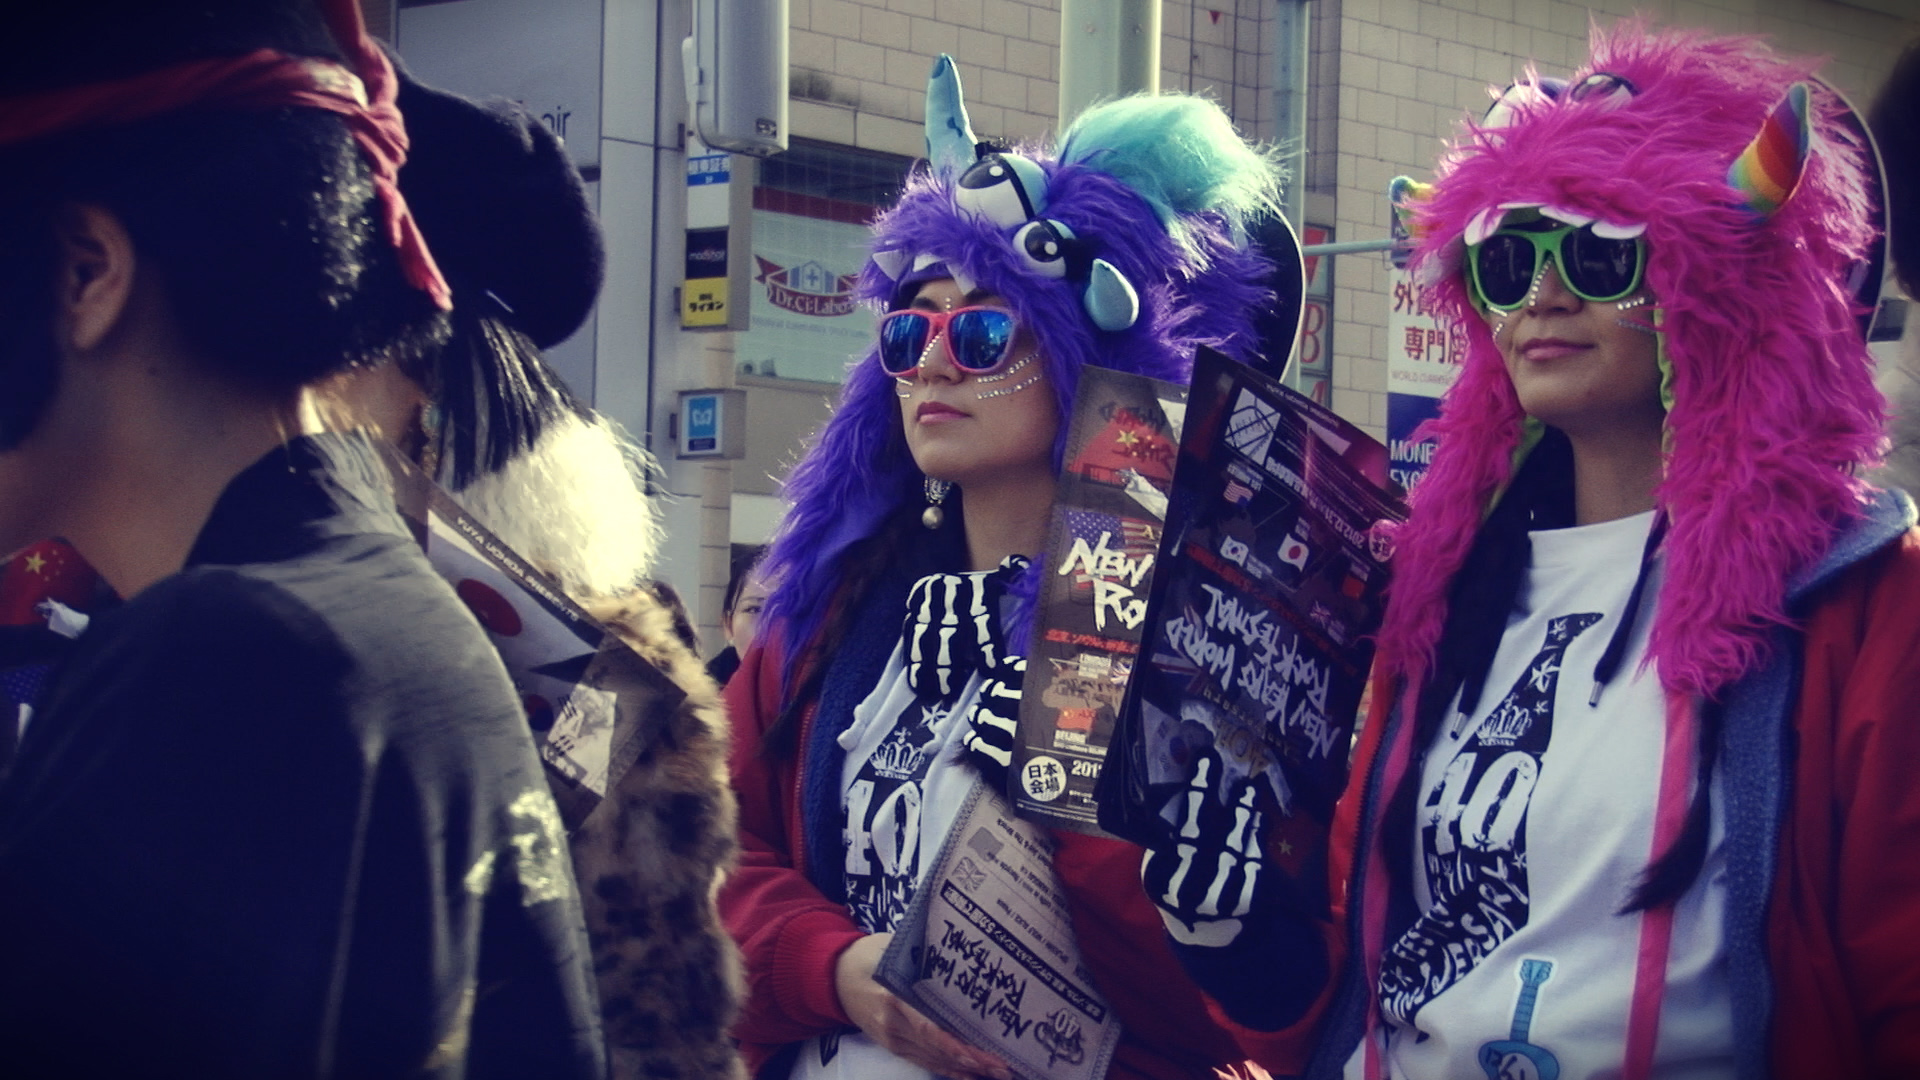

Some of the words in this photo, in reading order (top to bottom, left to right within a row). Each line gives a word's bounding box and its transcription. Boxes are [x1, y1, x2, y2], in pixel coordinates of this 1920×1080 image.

[1391, 439, 1436, 465] MONE
[1092, 578, 1148, 632] RO
[1202, 584, 1280, 667] FESTIVAL
[1166, 616, 1234, 690] WORLD
[1273, 634, 1331, 715] ROCK
[1235, 662, 1289, 733] YEARS
[1292, 700, 1342, 760] NEW
[1028, 762, 1058, 778] 日本
[937, 920, 989, 976] FESTIVAL
[953, 970, 989, 1018] YEARS
[981, 957, 1025, 1009] ROCK
[989, 997, 1032, 1039] NEW
